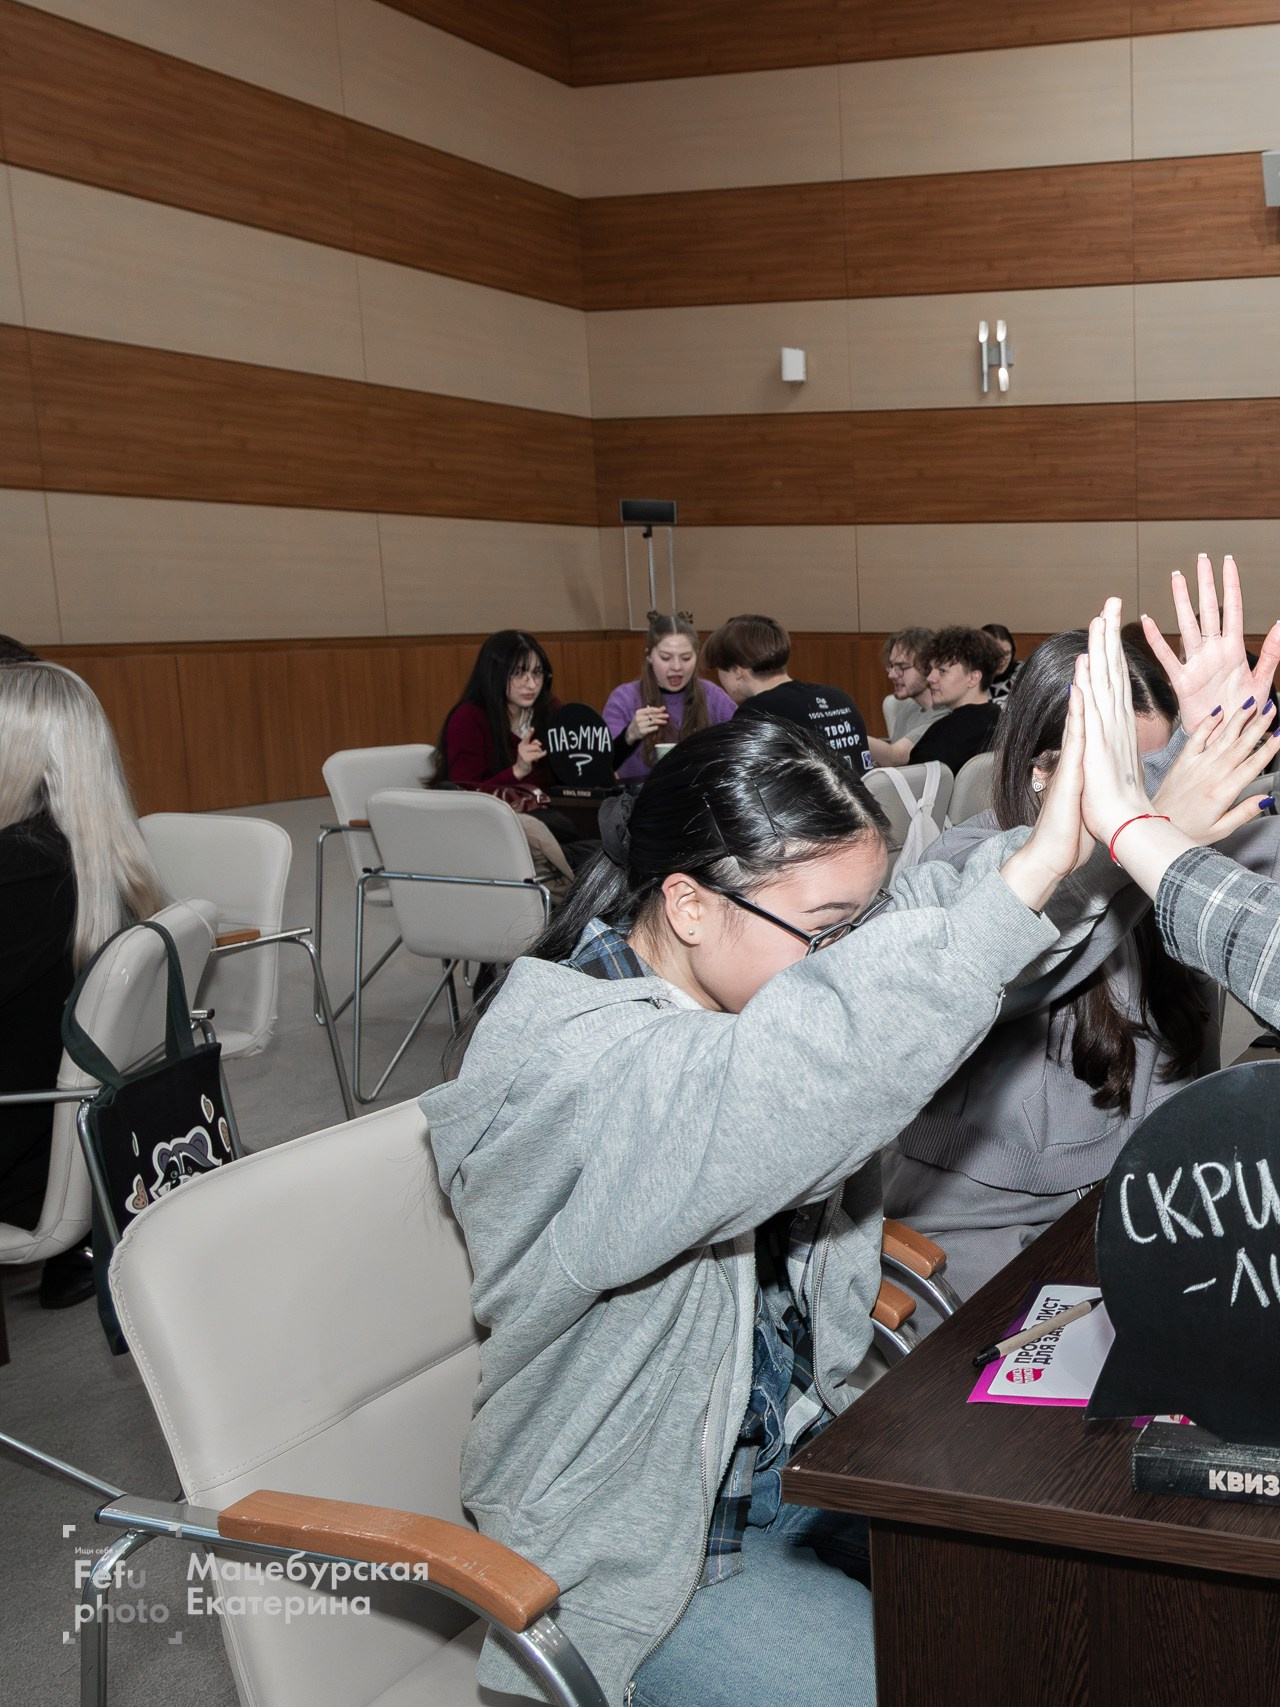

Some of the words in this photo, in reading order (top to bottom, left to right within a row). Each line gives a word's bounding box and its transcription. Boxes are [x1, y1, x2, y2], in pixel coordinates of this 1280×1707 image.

[824, 720, 852, 738] ТВОЙ
[828, 734, 860, 750] ЕНТОР
[568, 753, 593, 776] ?
[1036, 1296, 1061, 1322] ЛИСТ
[1032, 1344, 1055, 1366] ДЛЯ
